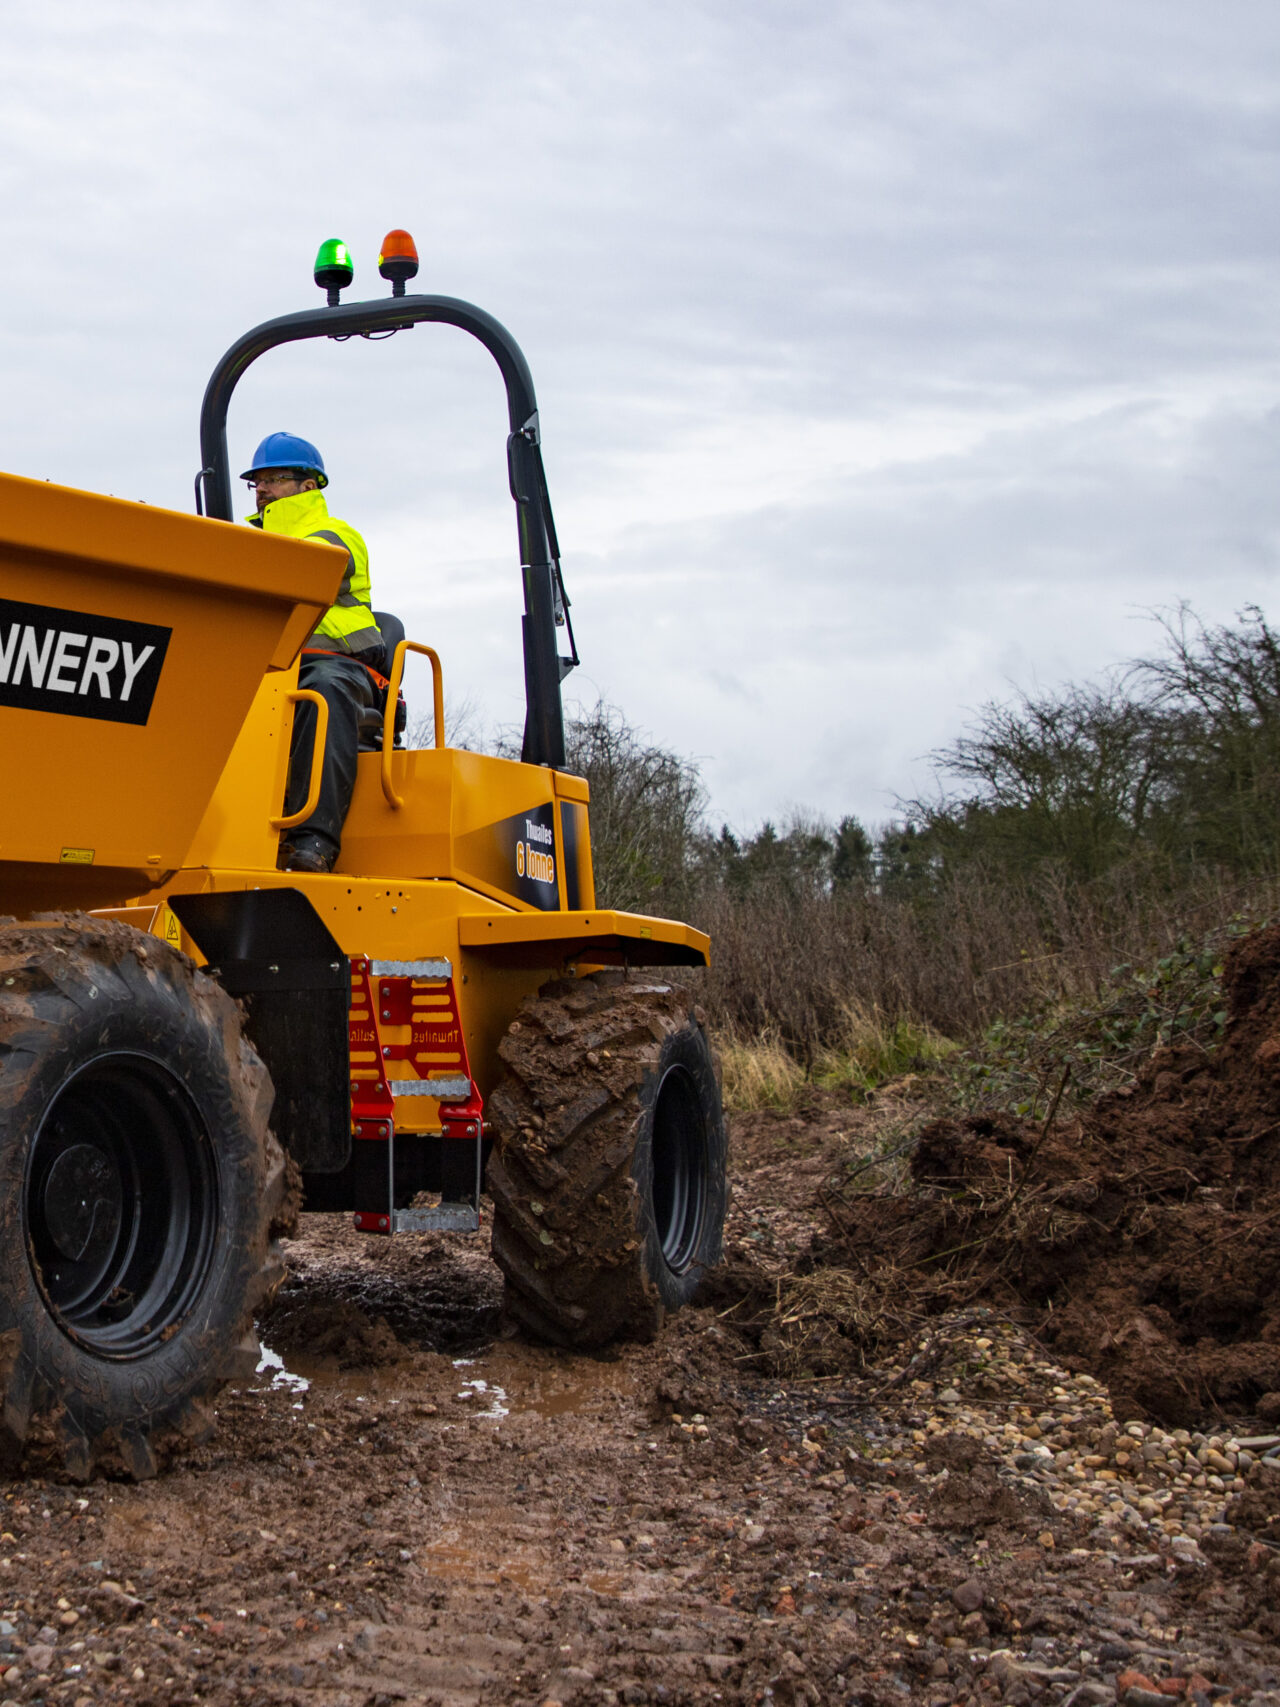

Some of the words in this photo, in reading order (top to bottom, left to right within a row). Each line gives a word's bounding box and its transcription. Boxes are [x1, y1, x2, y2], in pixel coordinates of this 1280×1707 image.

[526, 819, 552, 845] Thwaites
[517, 841, 525, 877] 6
[526, 843, 554, 883] tonne
